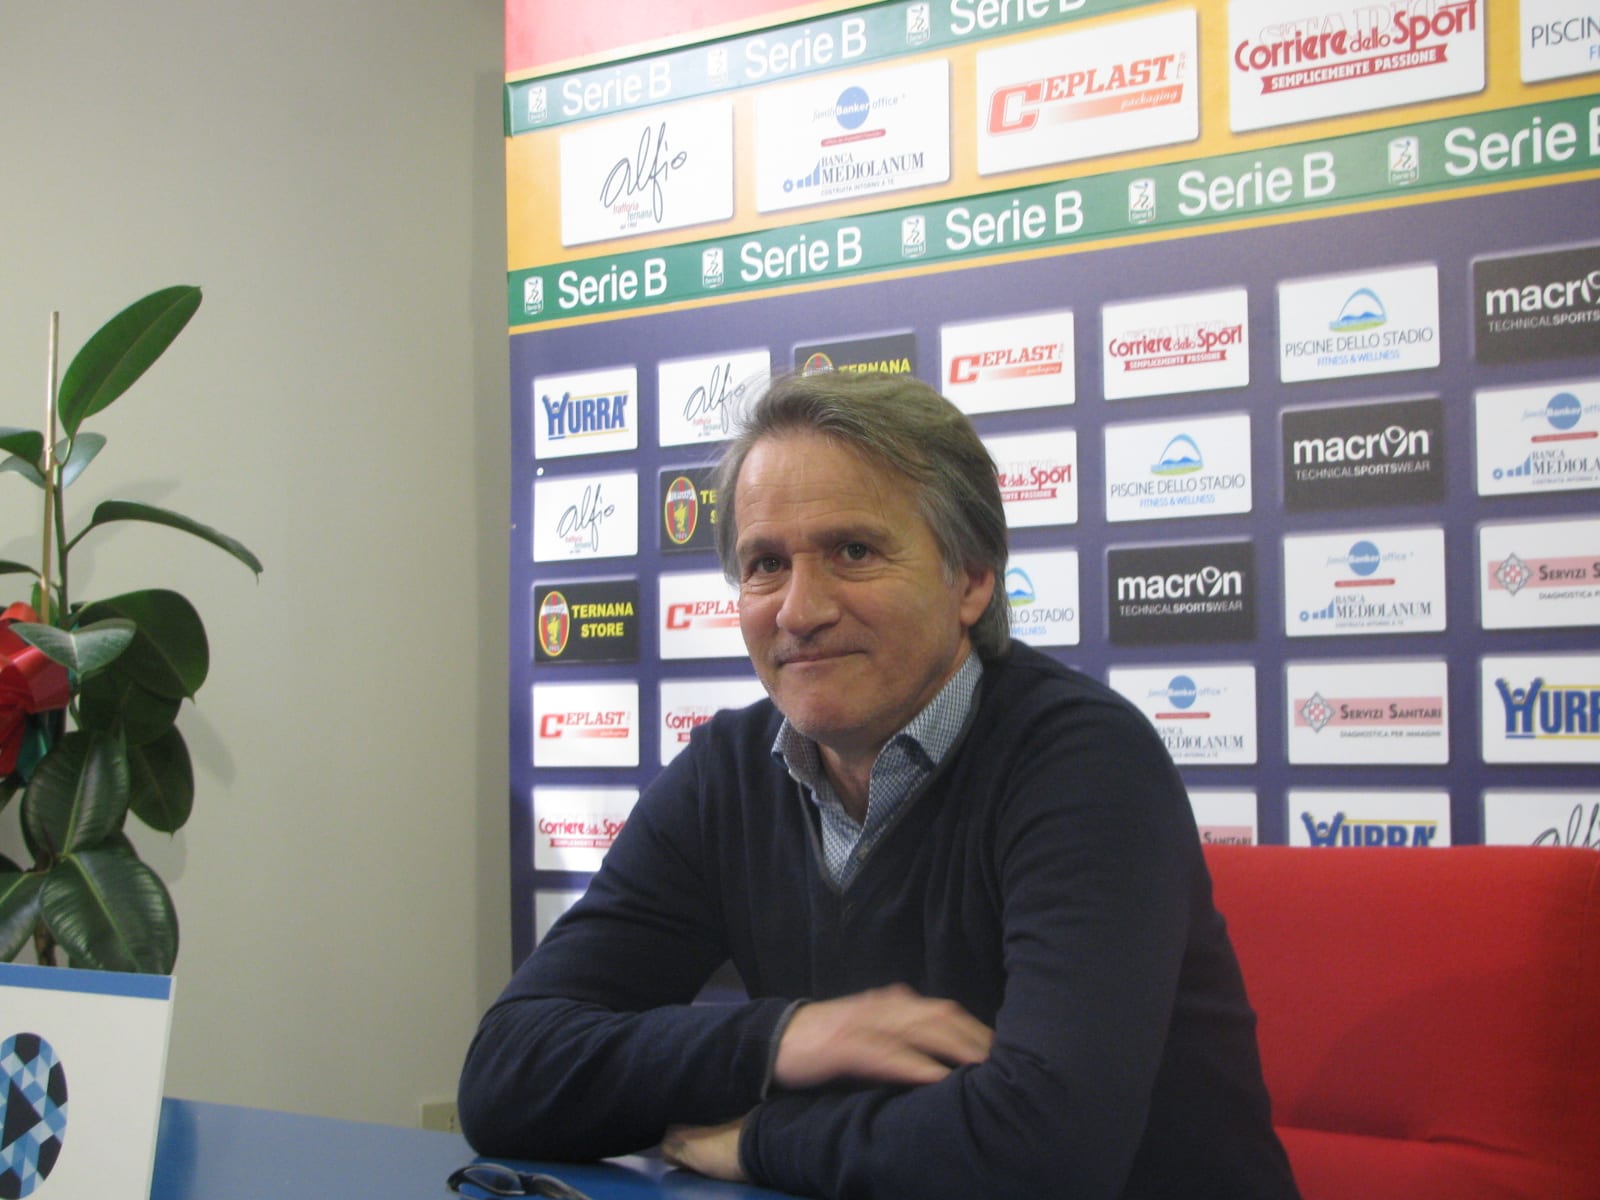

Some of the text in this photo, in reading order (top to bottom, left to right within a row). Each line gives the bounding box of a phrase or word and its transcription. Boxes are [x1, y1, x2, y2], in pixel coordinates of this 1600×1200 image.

[949, 0, 1049, 35] Serie
[1531, 16, 1600, 49] PISCIN
[745, 17, 867, 79] Serie B
[1234, 30, 1348, 71] Corriere
[1350, 26, 1391, 53] dello
[1393, 0, 1477, 50] Sport
[1271, 49, 1438, 89] SEMPLICEMENTE PASSIONE
[562, 60, 672, 116] Serie B
[987, 54, 1175, 136] CEPLAST
[1120, 90, 1178, 110] packaging
[821, 153, 854, 168] BANCA
[1444, 117, 1577, 177] Serie
[821, 152, 925, 184] MEDIOLANUM
[1178, 150, 1336, 216] Serie B
[945, 190, 1083, 251] Serie B
[740, 227, 863, 282] Serie B
[558, 257, 667, 309] Serie B
[1109, 335, 1172, 358] Corriere
[1197, 323, 1242, 353] Sport
[1285, 327, 1433, 357] PISCINE DELLO STADIO
[949, 344, 1058, 384] CEPLAST
[1317, 355, 1348, 367] FITNESS
[1358, 350, 1400, 363] WELLNESS
[1293, 426, 1429, 465] macron
[1030, 464, 1072, 491] Sport
[1111, 474, 1246, 497] PISCINE DELLO STADIO
[1117, 566, 1242, 601] macron
[571, 602, 634, 619] TERNANA
[1031, 607, 1075, 624] STADIO
[1335, 601, 1432, 619] MEDIOLANUM
[581, 622, 624, 638] STORE
[540, 711, 625, 738] CEPLAST
[538, 818, 585, 834] Corriere
